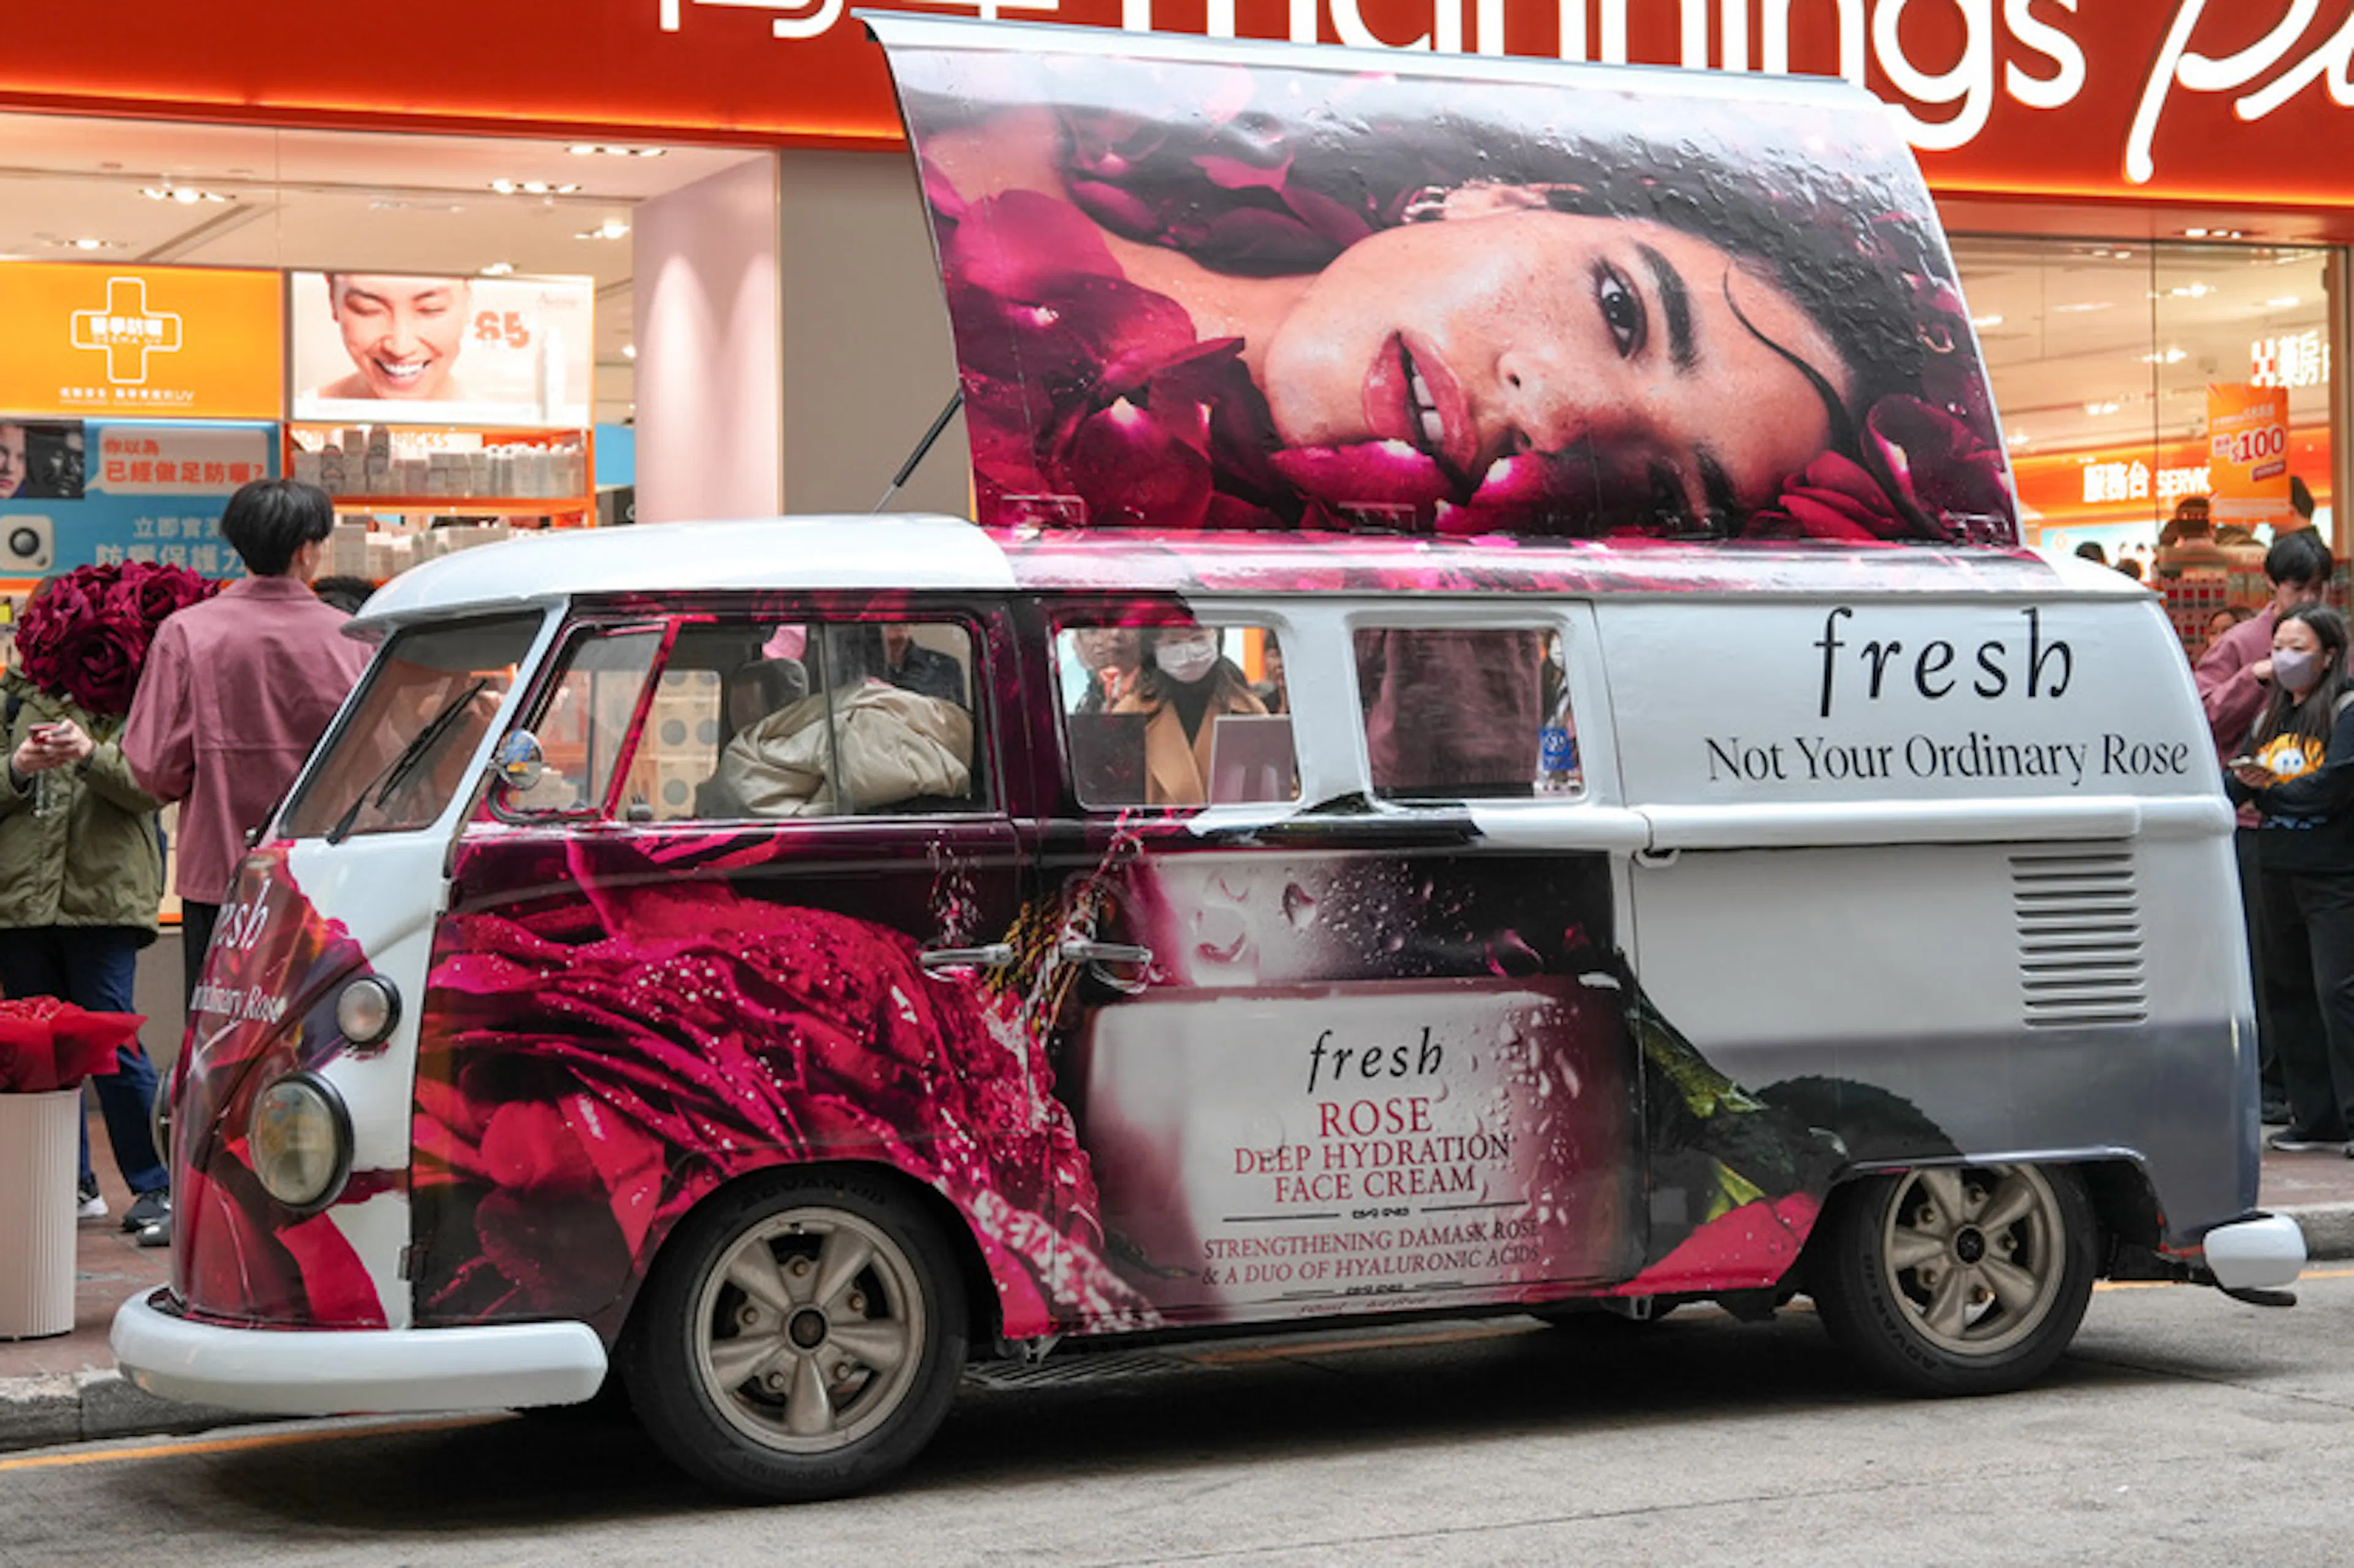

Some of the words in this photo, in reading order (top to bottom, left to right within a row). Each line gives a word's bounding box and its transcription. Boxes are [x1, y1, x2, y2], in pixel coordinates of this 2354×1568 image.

[1814, 606, 2073, 718] fresh
[1707, 736, 1787, 780] Not
[1794, 736, 1893, 779] Your
[1905, 732, 2087, 786] Ordinary
[2101, 733, 2189, 776] Rose
[1307, 1026, 1444, 1094] fresh
[1316, 1096, 1433, 1138] ROSE
[1234, 1144, 1311, 1175] DEEP
[1324, 1133, 1510, 1171] HYDRATION
[1274, 1172, 1352, 1203] FACE
[1363, 1164, 1476, 1198] CREAM
[1203, 1230, 1393, 1260] STRENGTHENING
[1398, 1222, 1488, 1249] DAMASK
[1494, 1219, 1540, 1241] ROSE
[1202, 1266, 1220, 1286] &
[1225, 1265, 1238, 1284] A
[1245, 1262, 1293, 1284] DUO
[1299, 1259, 1332, 1281] OF
[1335, 1248, 1482, 1279] HYALURONIC
[1486, 1242, 1540, 1268] ACIDS
